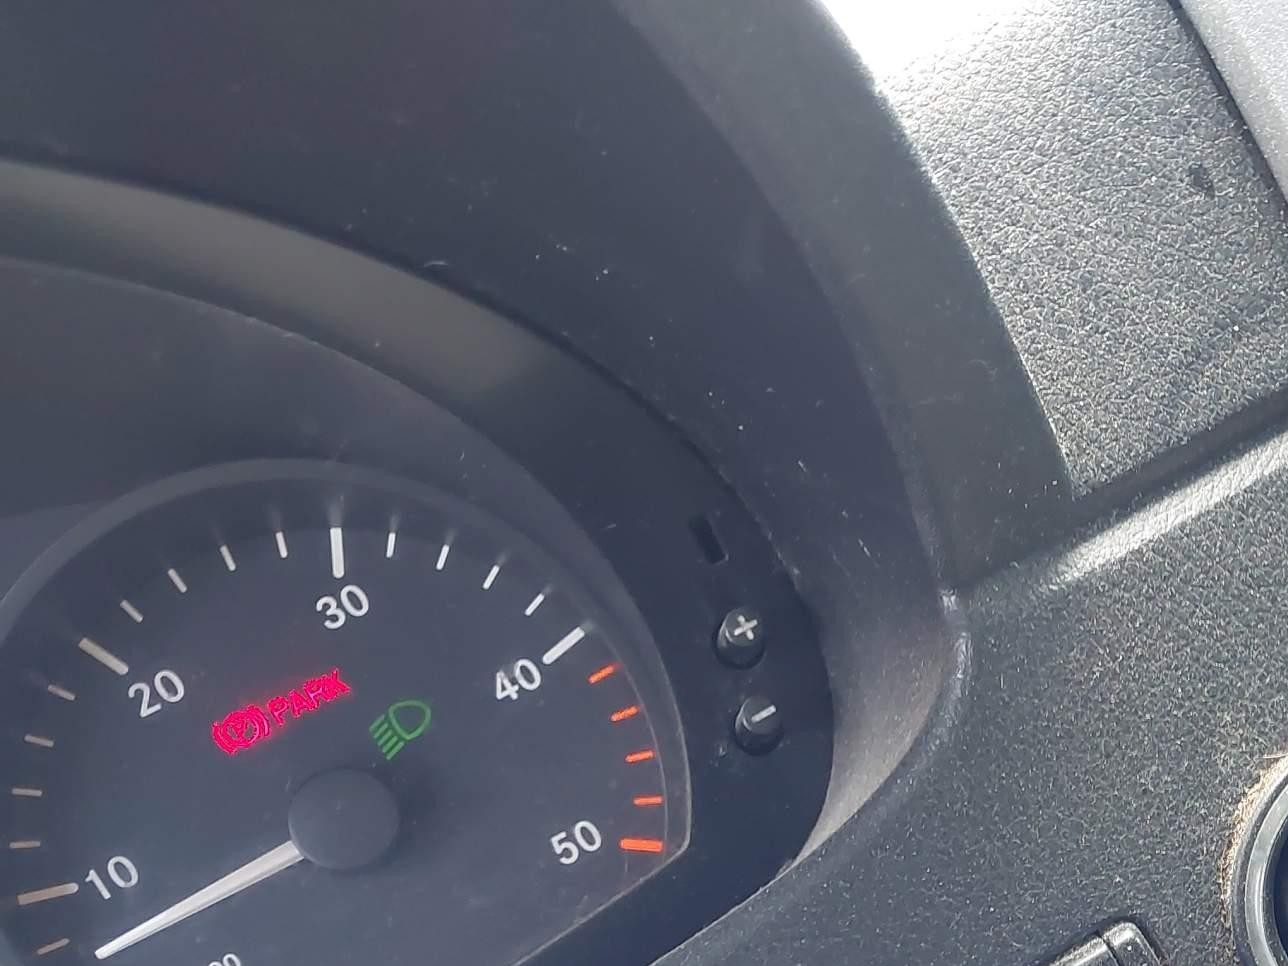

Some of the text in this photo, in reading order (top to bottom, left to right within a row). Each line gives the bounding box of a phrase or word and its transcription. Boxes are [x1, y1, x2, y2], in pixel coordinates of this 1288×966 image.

[315, 584, 370, 629] 30
[128, 669, 185, 718] 20
[266, 668, 351, 727] PARK
[495, 657, 542, 701] 40
[550, 820, 602, 866] 50
[85, 855, 139, 900] 10
